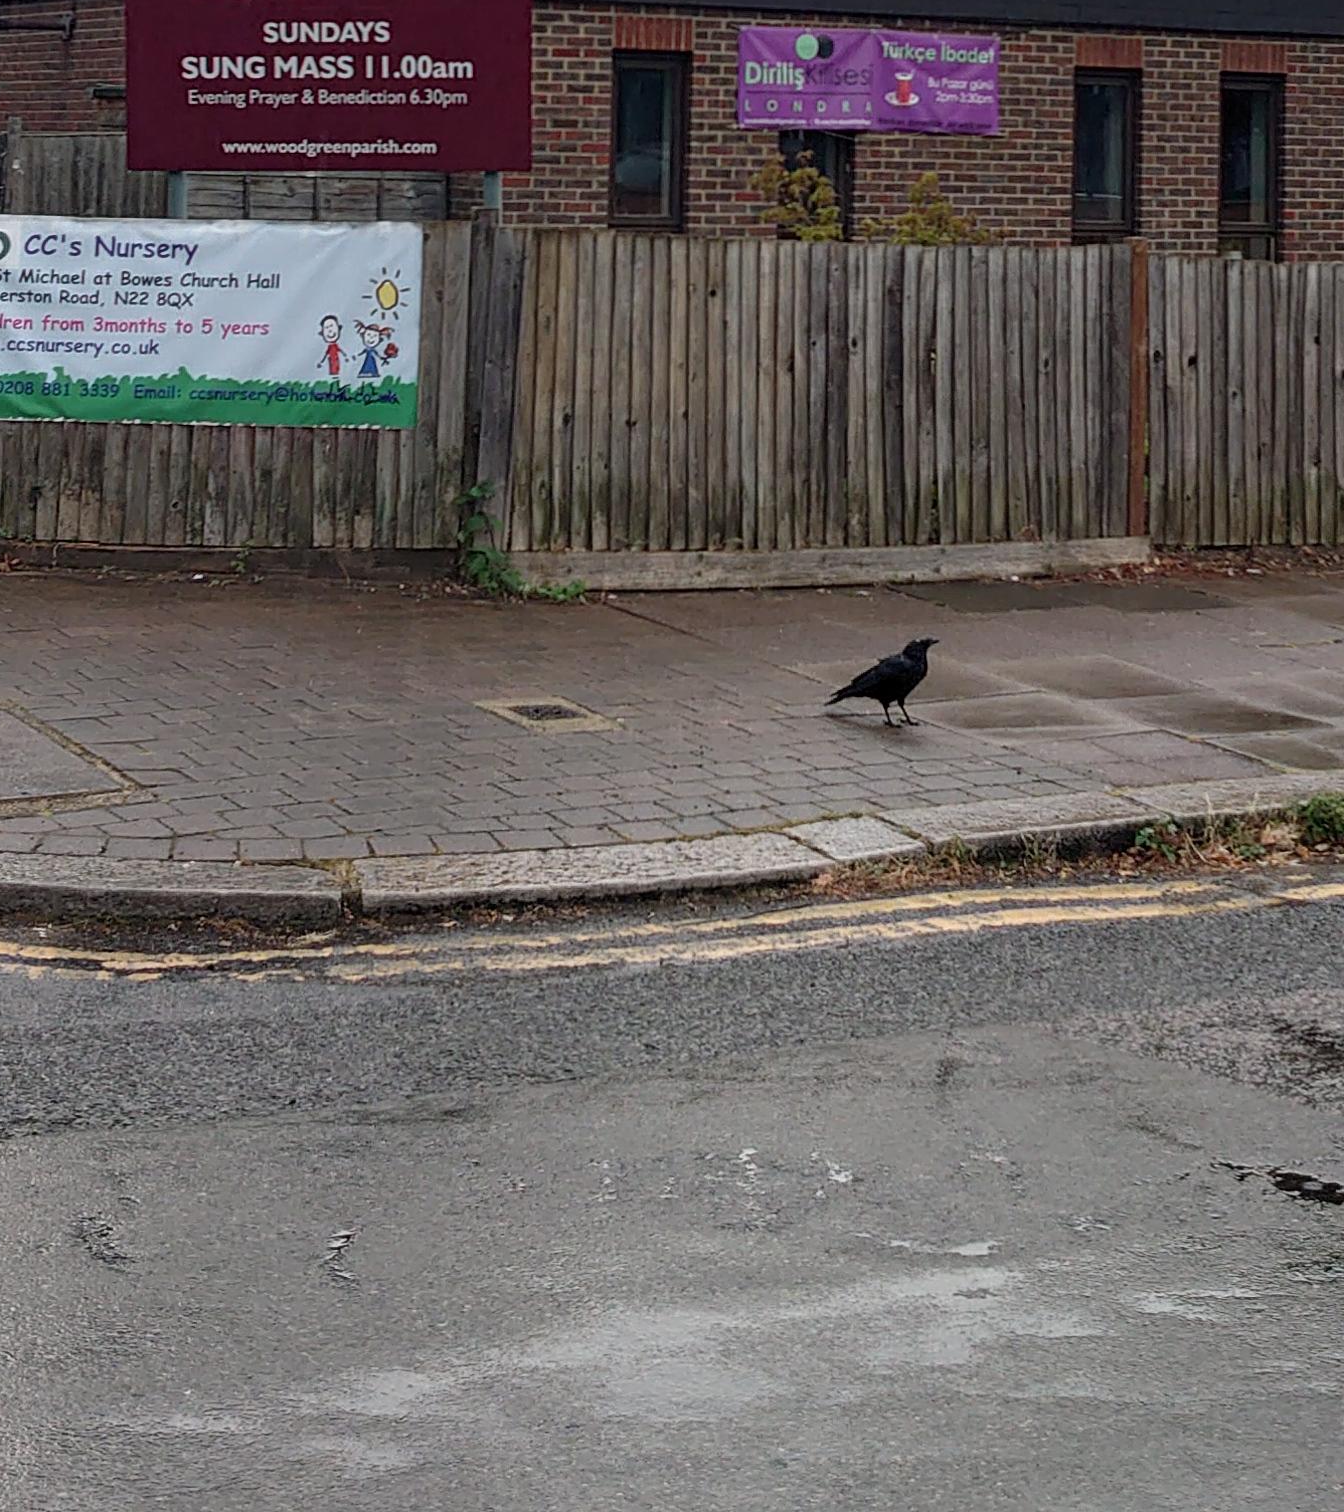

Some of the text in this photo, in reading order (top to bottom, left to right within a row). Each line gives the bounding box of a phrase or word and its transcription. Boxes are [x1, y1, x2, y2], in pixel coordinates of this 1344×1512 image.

[263, 21, 391, 44] SUNDAYS
[882, 40, 936, 63] Türkçe
[181, 55, 473, 80] SUNG MASS 11.00am
[188, 89, 467, 108] Evening Prayer & Benediction 6.30pm
[222, 140, 437, 158] www.woodgreenparish.com
[24, 233, 198, 264] CC's Nursery
[20, 269, 85, 286] Michael
[93, 274, 113, 287] at
[121, 272, 173, 288] Bowes
[180, 272, 239, 289] Church
[247, 274, 280, 289] Hall
[59, 289, 105, 307] Road,
[114, 291, 149, 306] N22
[157, 292, 194, 310] 8QX
[42, 315, 85, 332] from
[93, 316, 167, 334] 3months
[174, 319, 195, 335] to
[201, 318, 214, 335] 5
[220, 321, 270, 339] years
[41, 381, 70, 396] 881
[80, 383, 119, 398] 3339
[133, 384, 181, 400] Email:
